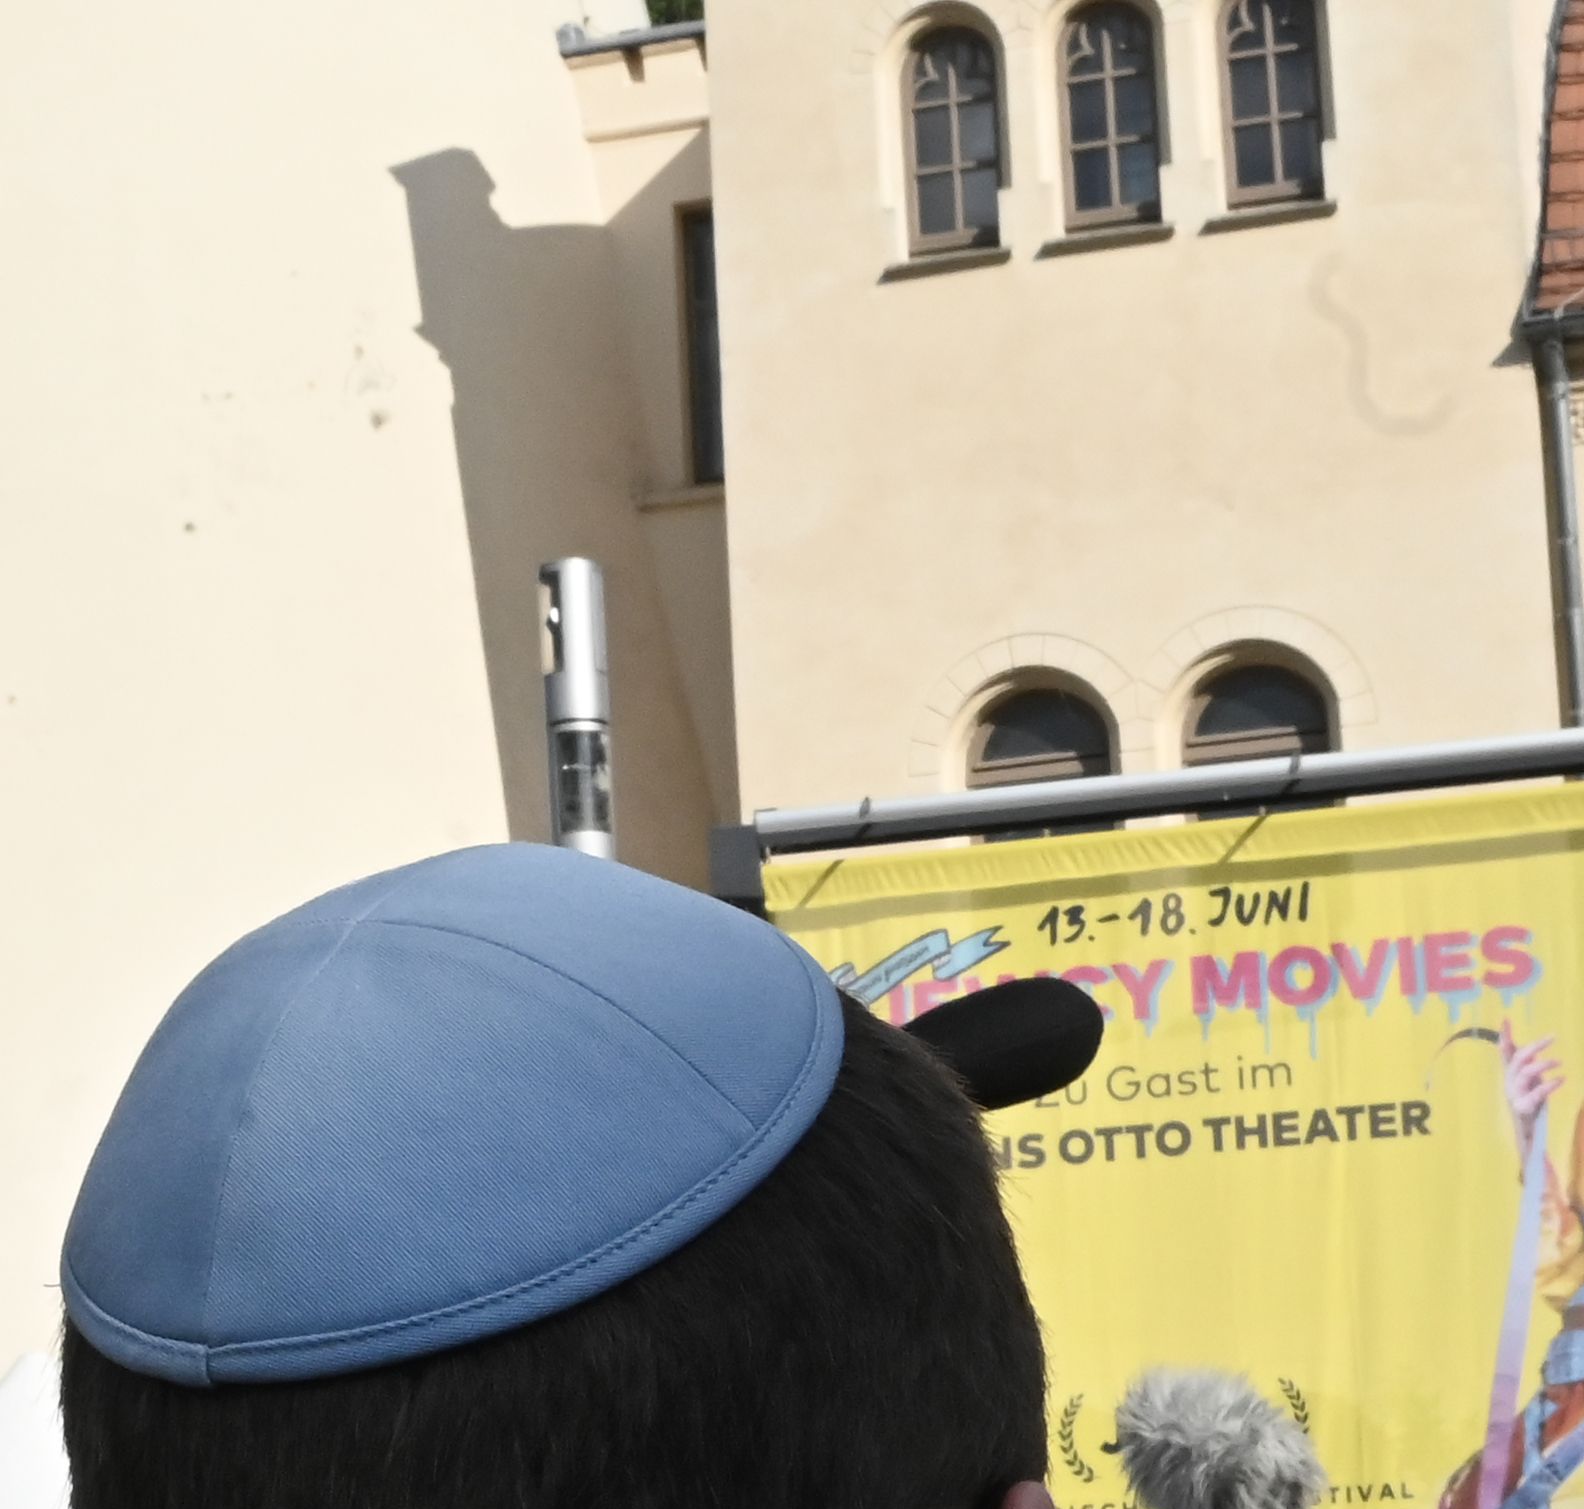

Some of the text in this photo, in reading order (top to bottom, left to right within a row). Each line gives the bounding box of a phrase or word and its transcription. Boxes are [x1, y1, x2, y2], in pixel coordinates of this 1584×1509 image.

[1208, 881, 1309, 926] JUNI
[1190, 925, 1543, 1030] MOVIES
[1106, 1061, 1221, 1102] Gast
[1236, 1055, 1293, 1091] im
[1057, 1119, 1192, 1165] OTTO
[1202, 1100, 1432, 1153] THEATER
